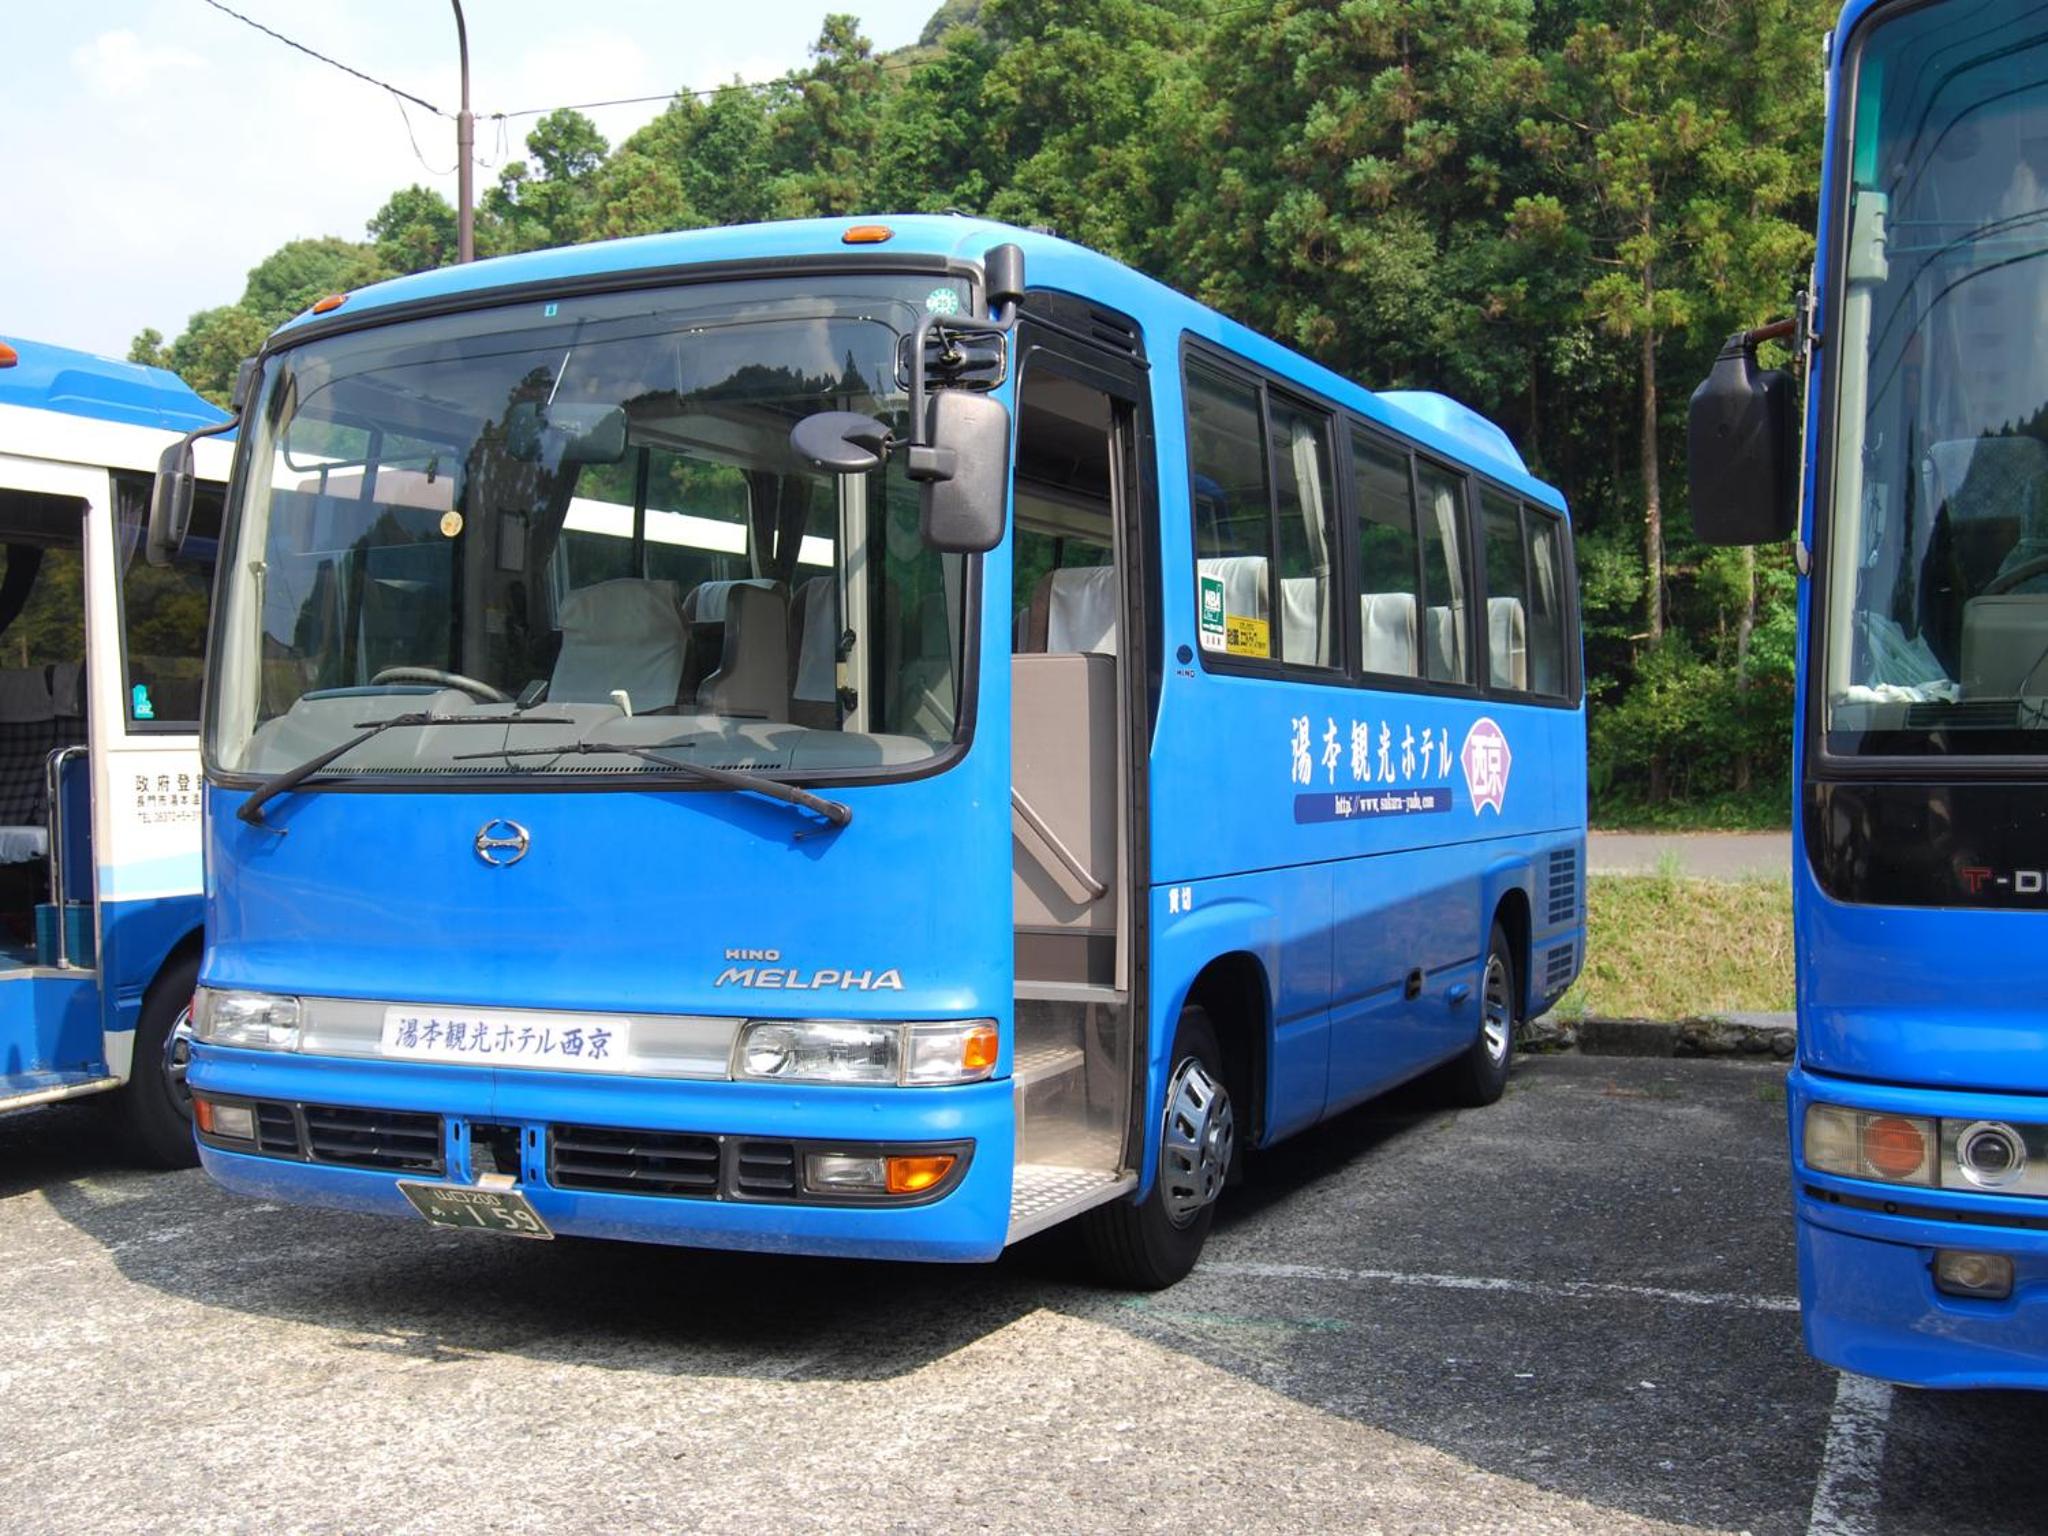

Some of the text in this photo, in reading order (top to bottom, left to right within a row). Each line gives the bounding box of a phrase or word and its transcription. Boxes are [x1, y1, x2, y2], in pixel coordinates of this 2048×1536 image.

[1290, 715, 1453, 786] 湯本観光ホテル
[1470, 734, 1503, 797] 西京
[1960, 866, 2048, 895] T-D
[725, 949, 781, 962] HINO
[714, 966, 905, 991] MELPHA
[395, 1018, 612, 1060] 湯本観光ホテル西京
